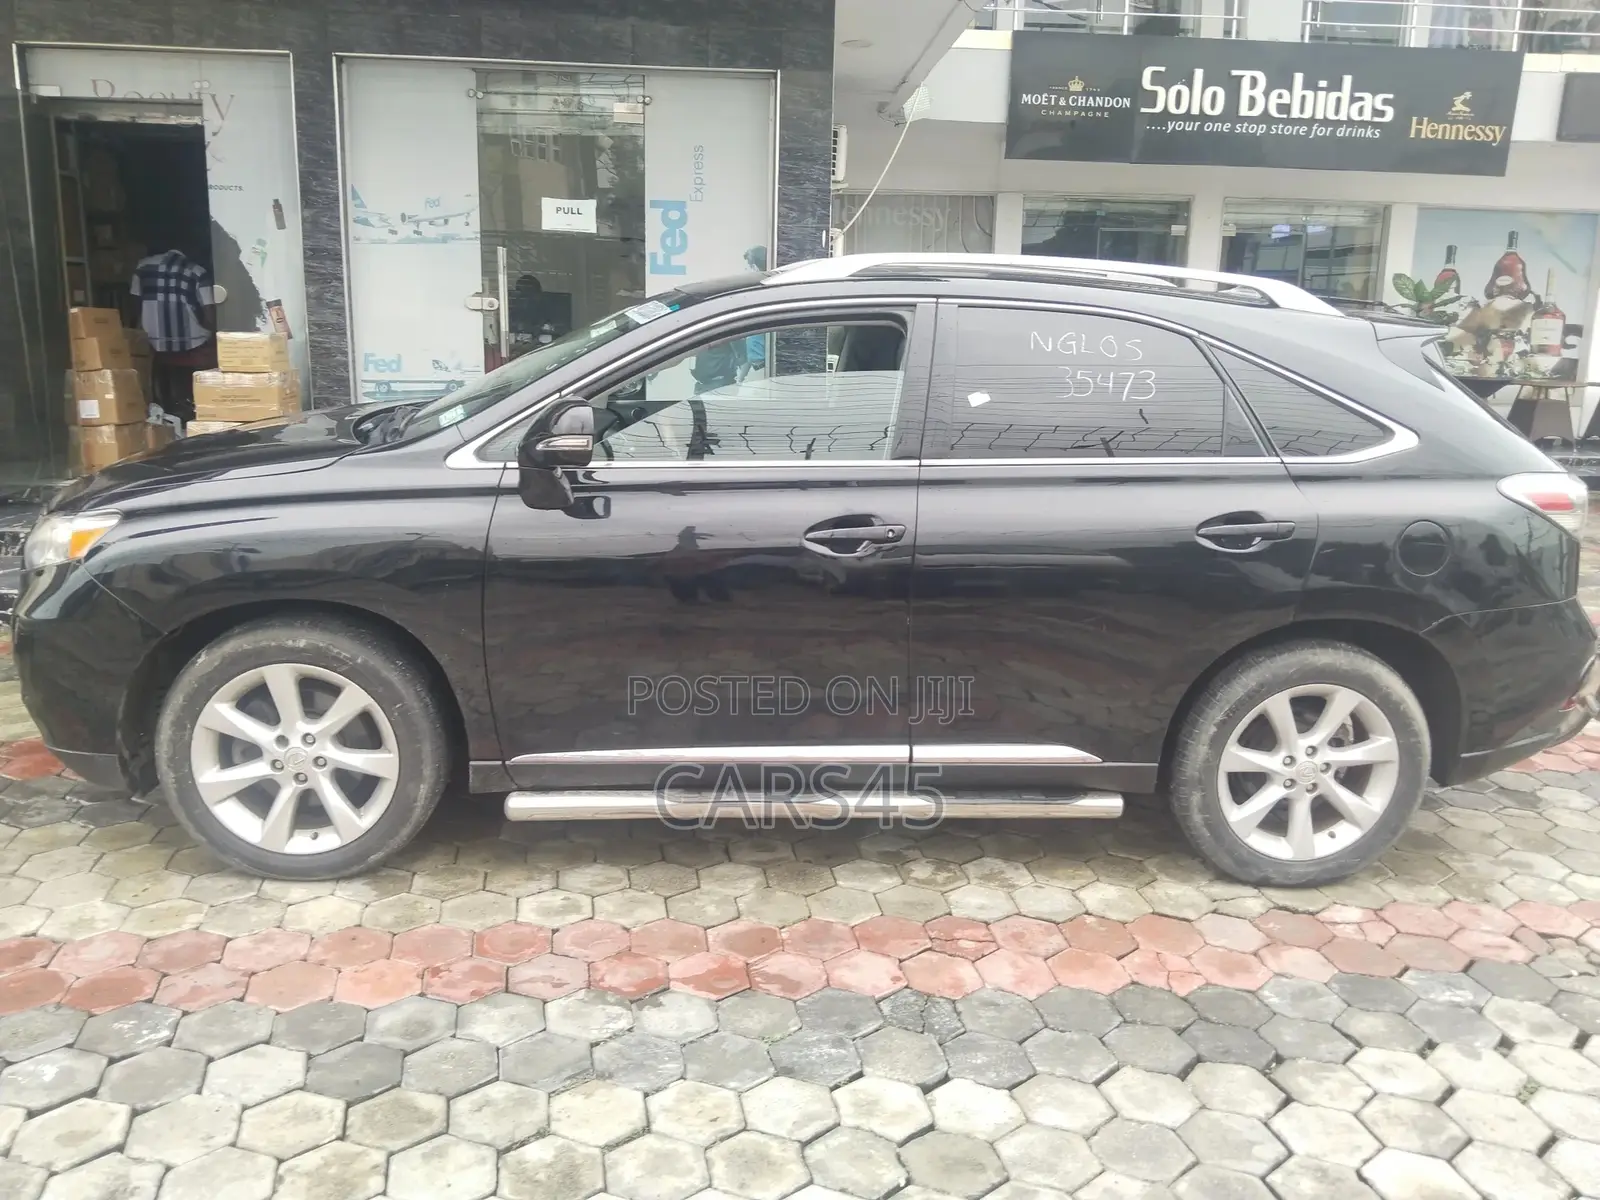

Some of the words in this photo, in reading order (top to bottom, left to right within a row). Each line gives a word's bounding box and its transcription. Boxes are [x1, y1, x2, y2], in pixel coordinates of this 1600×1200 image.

[1021, 93, 1057, 106] MOËT
[1059, 96, 1066, 106] &
[1068, 95, 1131, 108] CHANDON
[1230, 69, 1394, 123] Bebidas
[1041, 109, 1109, 118] CHAMPAGNE
[1203, 122, 1231, 132] one
[1234, 121, 1267, 135] stop
[1270, 124, 1308, 136] store
[1308, 123, 1334, 138] for
[1336, 125, 1381, 139] drinks
[1409, 116, 1507, 146] Hennessy
[689, 144, 707, 203] Express
[208, 184, 244, 192] RODUCTS.
[555, 206, 583, 216] PULL
[649, 199, 688, 276] Fed
[363, 352, 402, 373] Fed
[1055, 366, 1156, 401] 35473
